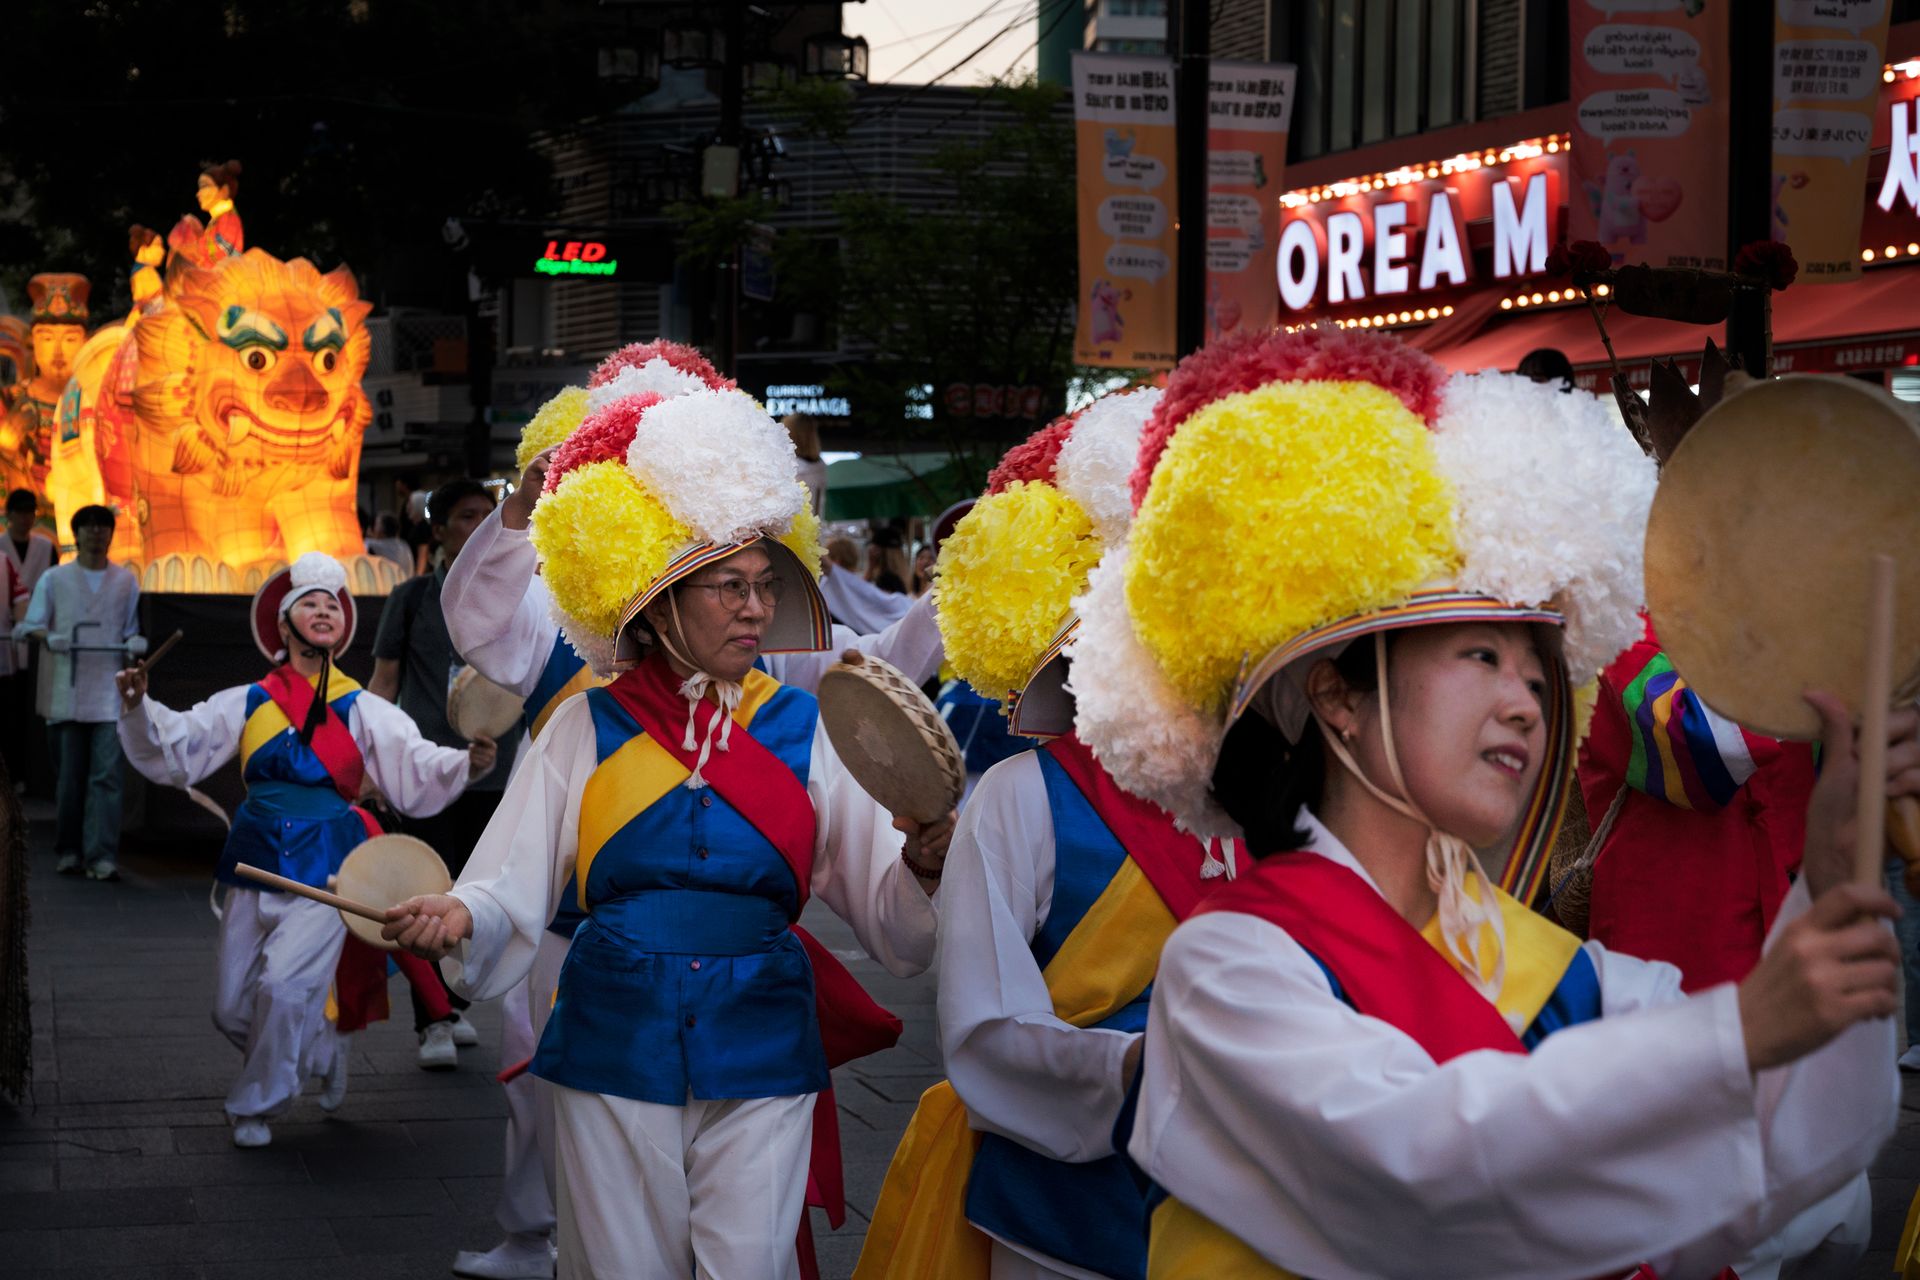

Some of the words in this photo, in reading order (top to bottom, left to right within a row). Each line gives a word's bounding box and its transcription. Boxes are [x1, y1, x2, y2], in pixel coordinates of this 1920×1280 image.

[544, 241, 606, 262] LED
[1277, 192, 1467, 311] OREA
[765, 398, 852, 417] EXCHANGE
